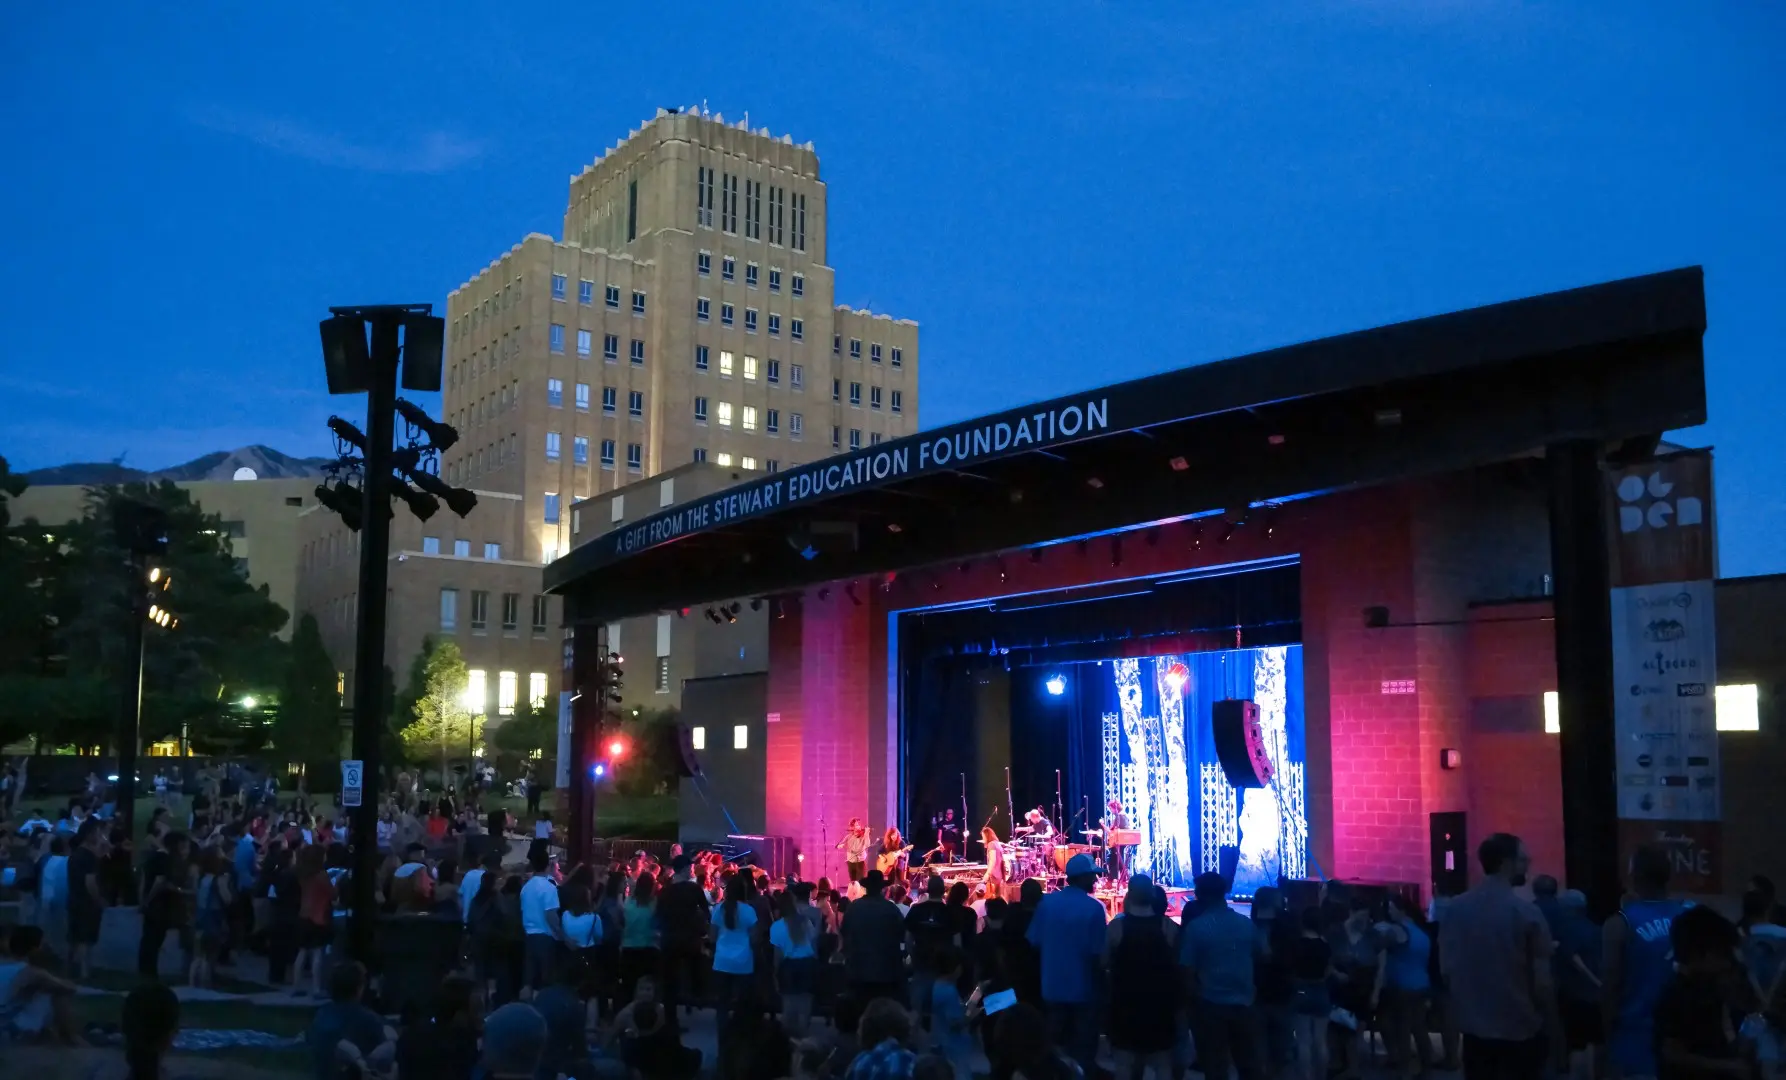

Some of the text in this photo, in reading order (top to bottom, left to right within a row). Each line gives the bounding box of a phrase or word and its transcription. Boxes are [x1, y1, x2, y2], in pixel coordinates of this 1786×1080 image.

[616, 398, 1108, 554] A GIFT FROM THE STEWART EDUCATION FOUNDATION
